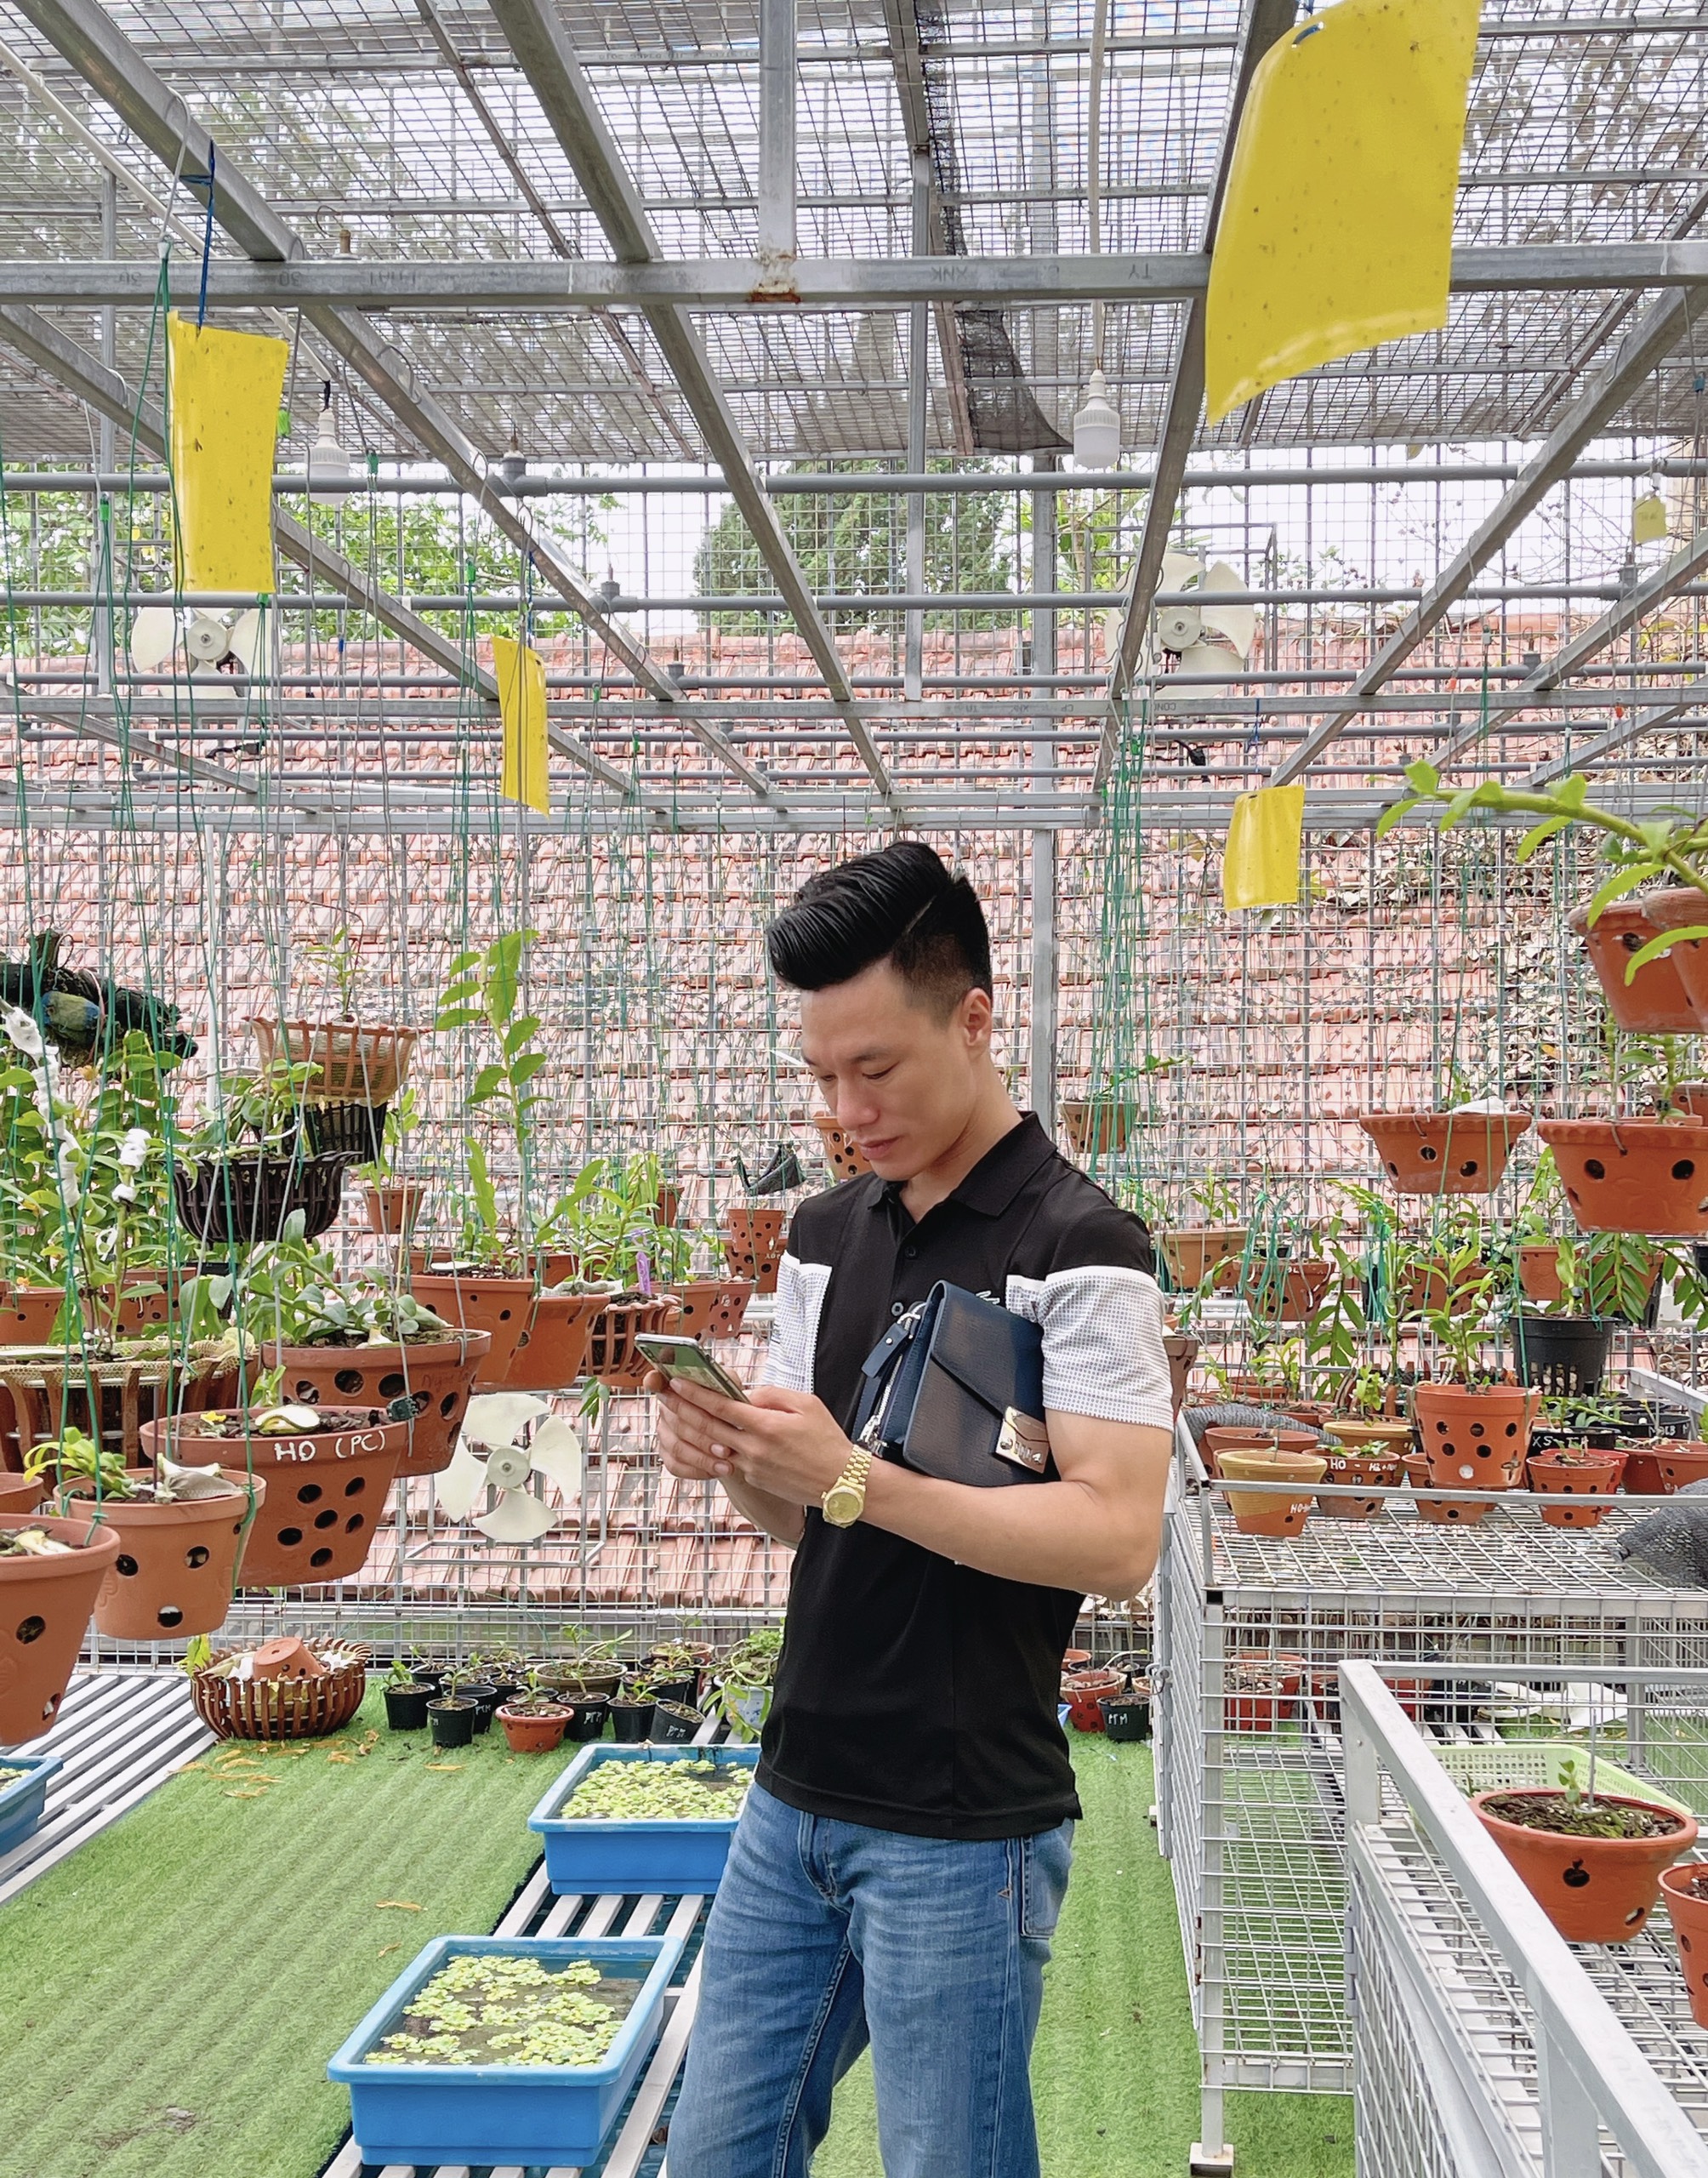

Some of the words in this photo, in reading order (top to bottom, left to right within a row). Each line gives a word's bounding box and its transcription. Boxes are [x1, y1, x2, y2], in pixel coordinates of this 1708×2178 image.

[930, 265, 968, 283] XNK
[1128, 263, 1153, 281] TY
[334, 1429, 386, 1459] (PC)
